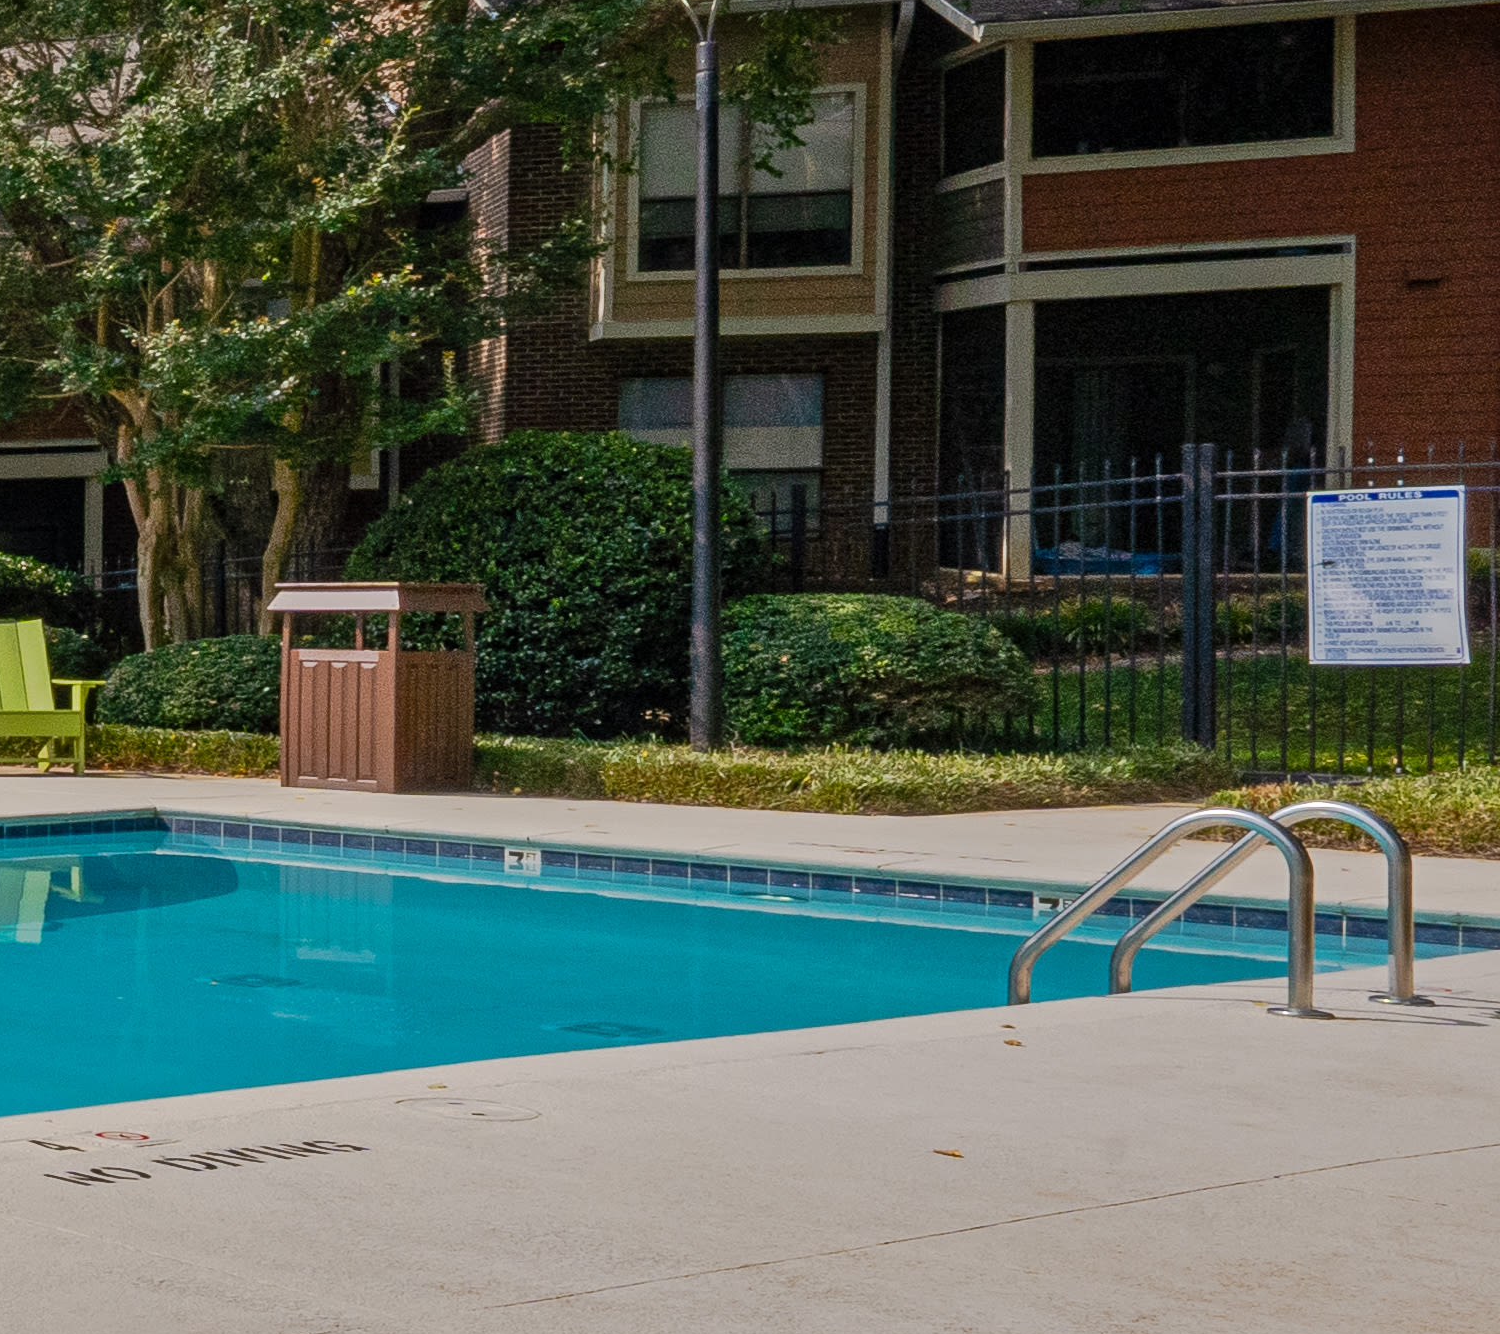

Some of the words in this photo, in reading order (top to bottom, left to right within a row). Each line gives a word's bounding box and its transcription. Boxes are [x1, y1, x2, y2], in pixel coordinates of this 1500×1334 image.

[1338, 493, 1373, 502] POOL
[1378, 491, 1423, 500] RULES
[43, 1166, 152, 1186] NO
[151, 1140, 371, 1172] DIVING
